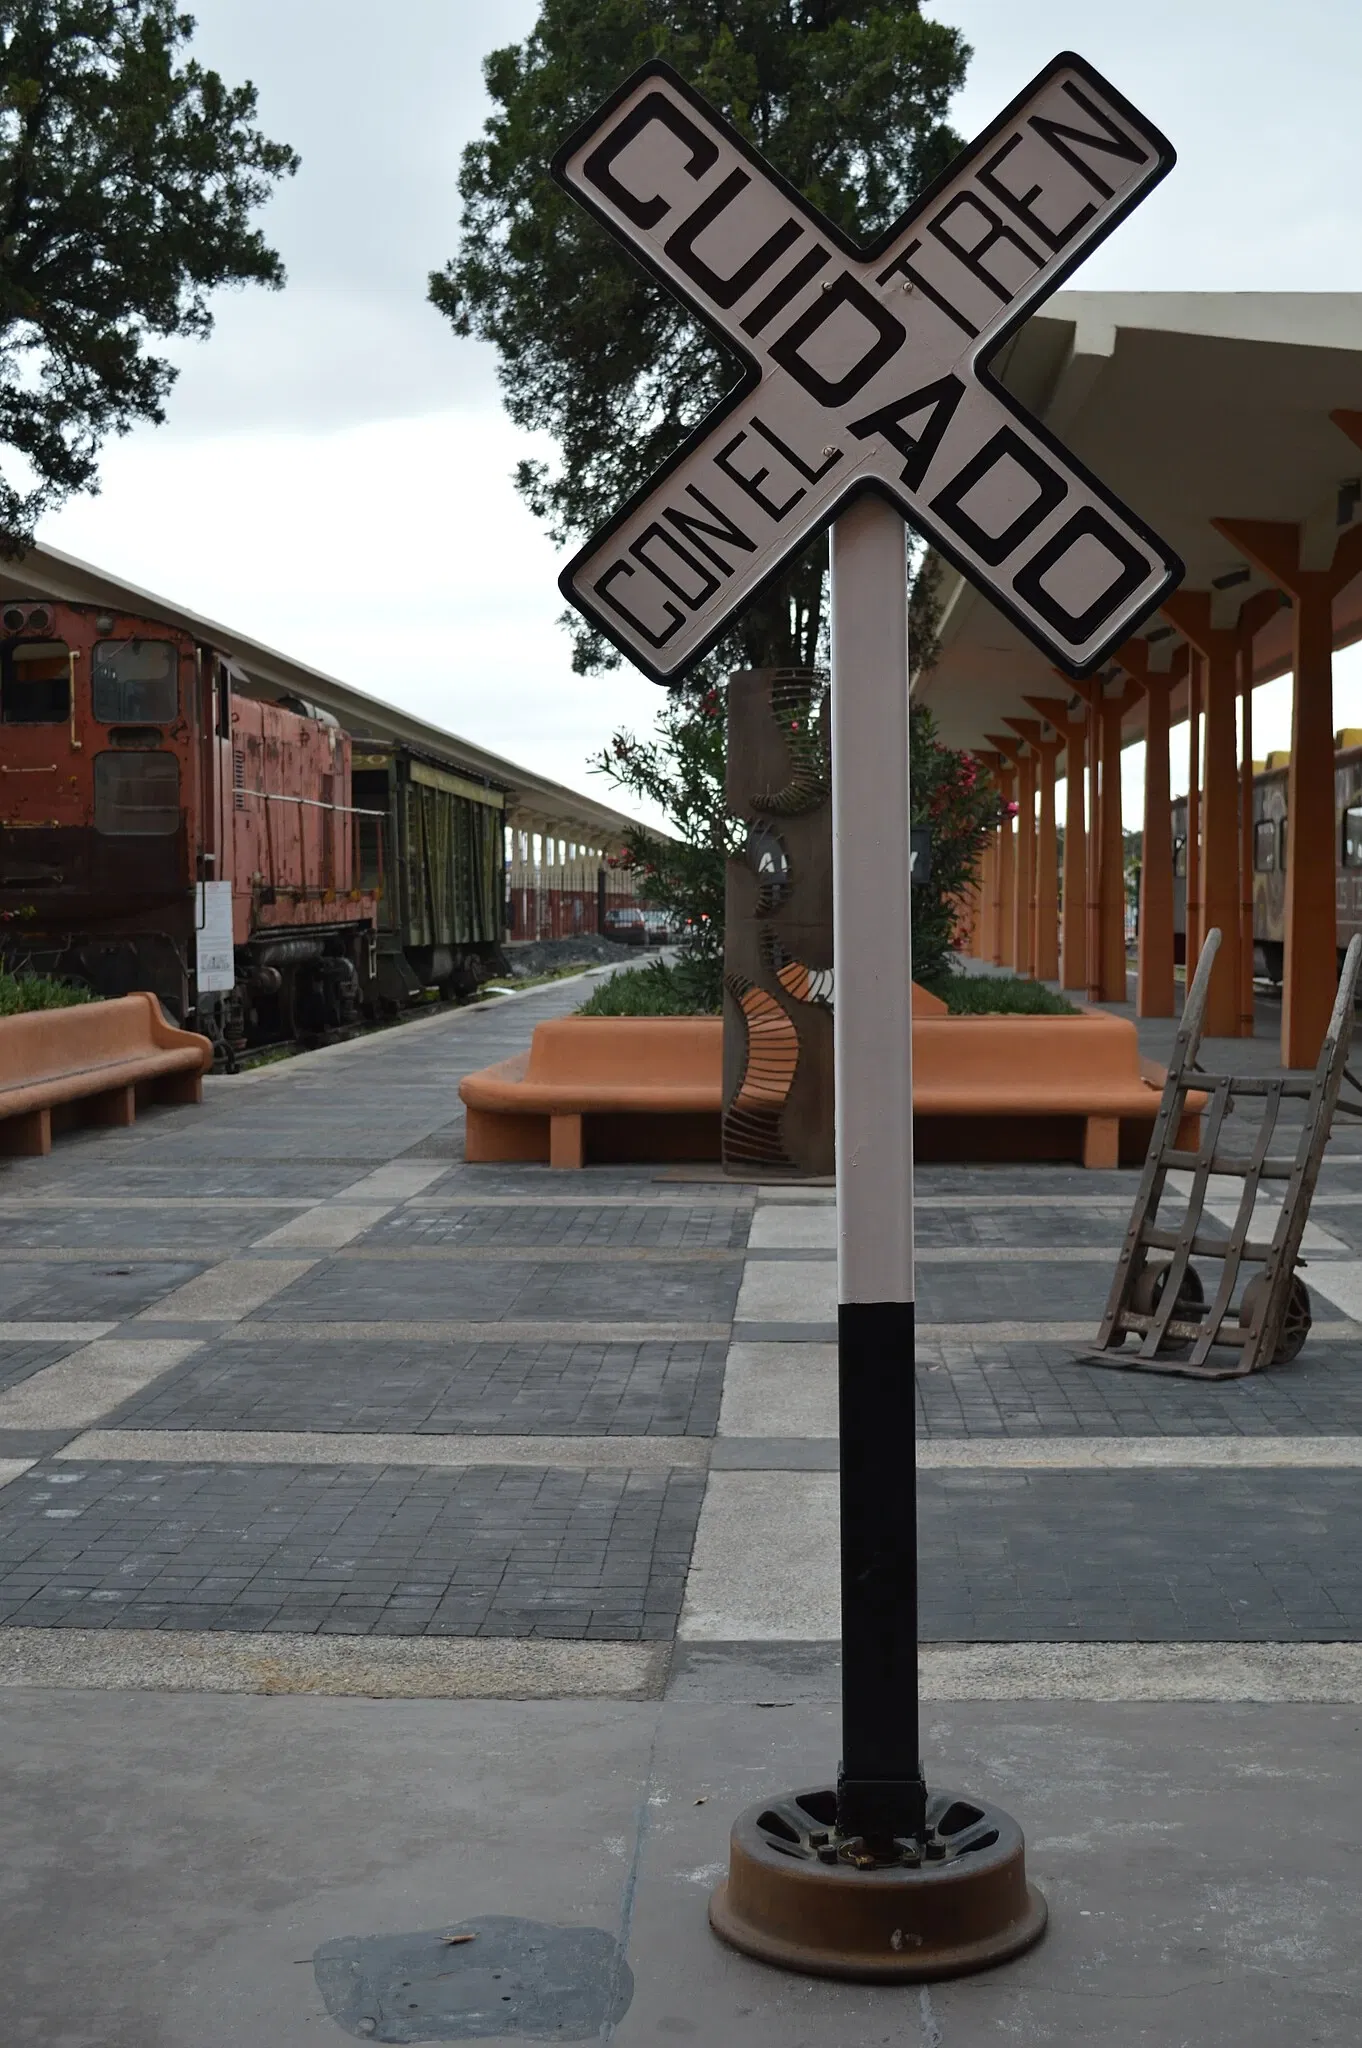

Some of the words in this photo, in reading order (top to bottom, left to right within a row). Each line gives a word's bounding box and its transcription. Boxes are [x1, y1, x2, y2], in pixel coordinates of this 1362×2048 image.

[583, 92, 1154, 646] CUIDADO
[593, 484, 758, 650] CON
[713, 416, 845, 523] EL
[875, 80, 1150, 340] TREN
